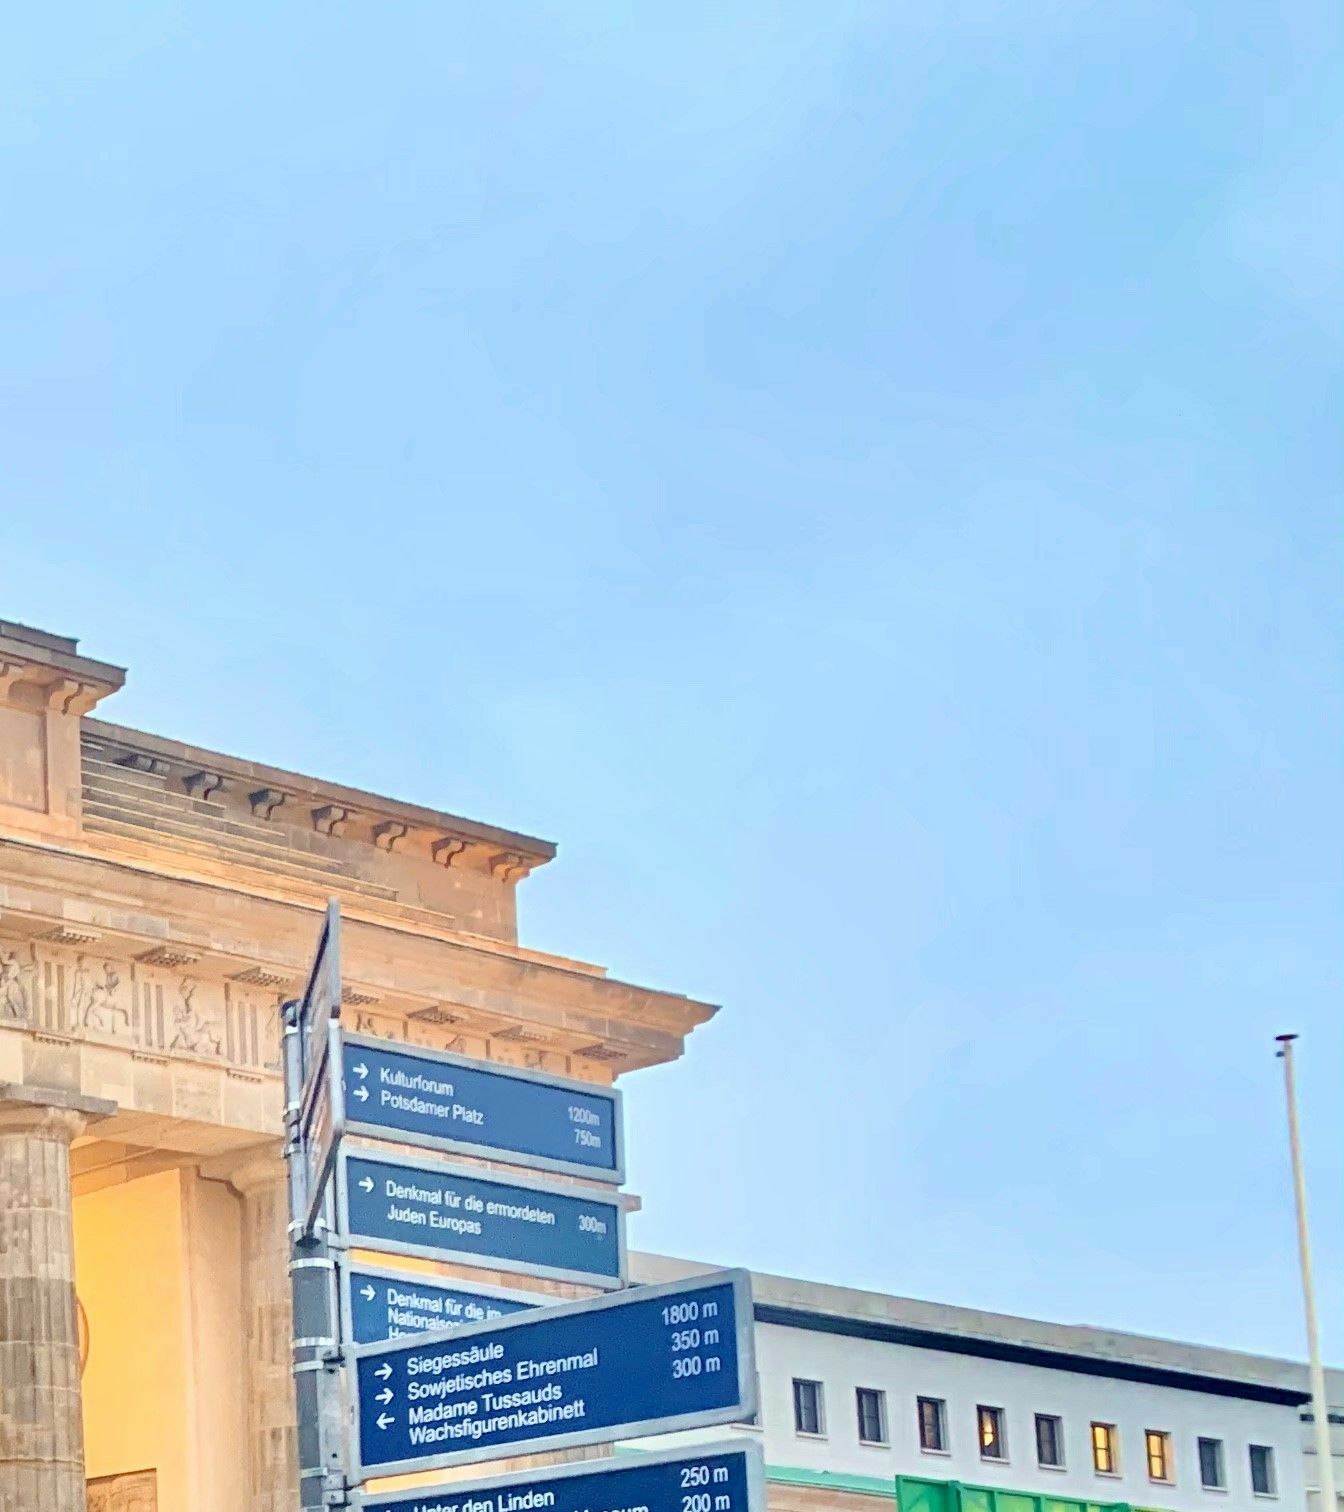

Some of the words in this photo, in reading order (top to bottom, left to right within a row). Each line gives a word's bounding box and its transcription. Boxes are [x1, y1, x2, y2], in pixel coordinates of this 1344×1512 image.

[380, 1067, 453, 1097] Kulturforum
[381, 1090, 449, 1118] Potsdamer
[452, 1105, 484, 1125] Platz
[568, 1106, 600, 1126] 1200m
[574, 1129, 601, 1148] 750m
[386, 1180, 442, 1206] Denkmal
[444, 1190, 462, 1209] für
[464, 1193, 483, 1213] die
[486, 1199, 555, 1226] ermordeten
[387, 1205, 427, 1227] Juden
[430, 1210, 482, 1236] Europas
[579, 1214, 606, 1235] 300m
[387, 1288, 442, 1313] Denkmal
[444, 1298, 463, 1315] für
[464, 1303, 484, 1319] die
[661, 1304, 698, 1325] 1800
[703, 1301, 718, 1317] m
[672, 1331, 700, 1352] 350
[704, 1328, 719, 1344] m
[407, 1342, 504, 1376] Siegessäule
[672, 1358, 700, 1379] 300
[705, 1355, 720, 1372] m
[408, 1367, 512, 1402] Sowjetisches
[517, 1348, 598, 1379] Ehrenmal
[409, 1398, 477, 1424] Madame
[481, 1384, 562, 1412] Tussauds
[409, 1400, 585, 1445] Wachsfigurenkabinett
[680, 1467, 709, 1488] 250
[714, 1466, 728, 1482] m
[715, 1494, 730, 1510] m
